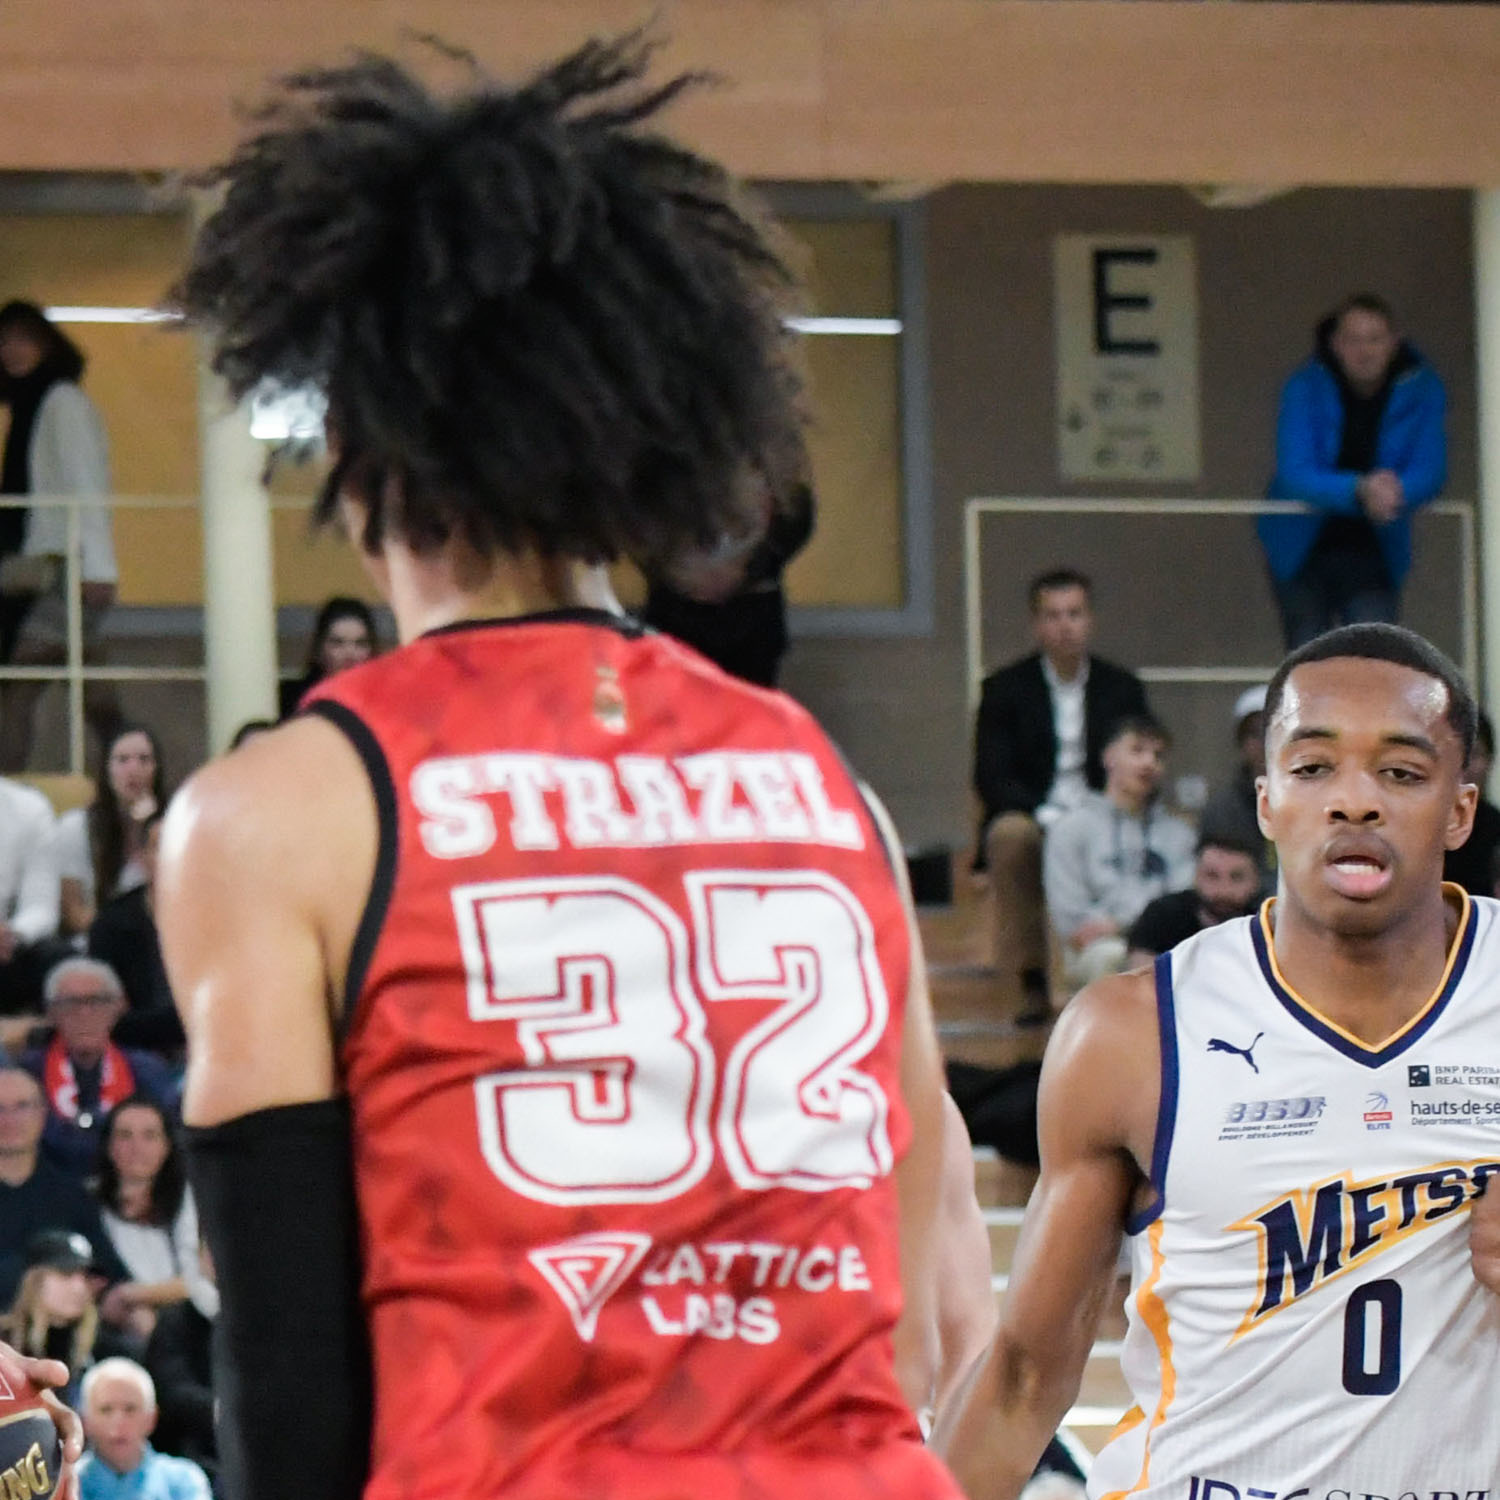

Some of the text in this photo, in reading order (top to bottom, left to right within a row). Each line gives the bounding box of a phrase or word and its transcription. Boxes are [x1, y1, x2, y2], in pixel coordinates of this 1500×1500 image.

[1092, 247, 1160, 356] E
[408, 751, 866, 860] STRAZEL
[450, 868, 894, 1206] 32
[1434, 1065, 1460, 1075] BNP
[1435, 1076, 1465, 1086] REAL
[642, 1241, 872, 1293] LATTICE
[641, 1293, 781, 1344] LABS
[1341, 1277, 1403, 1396] 0
